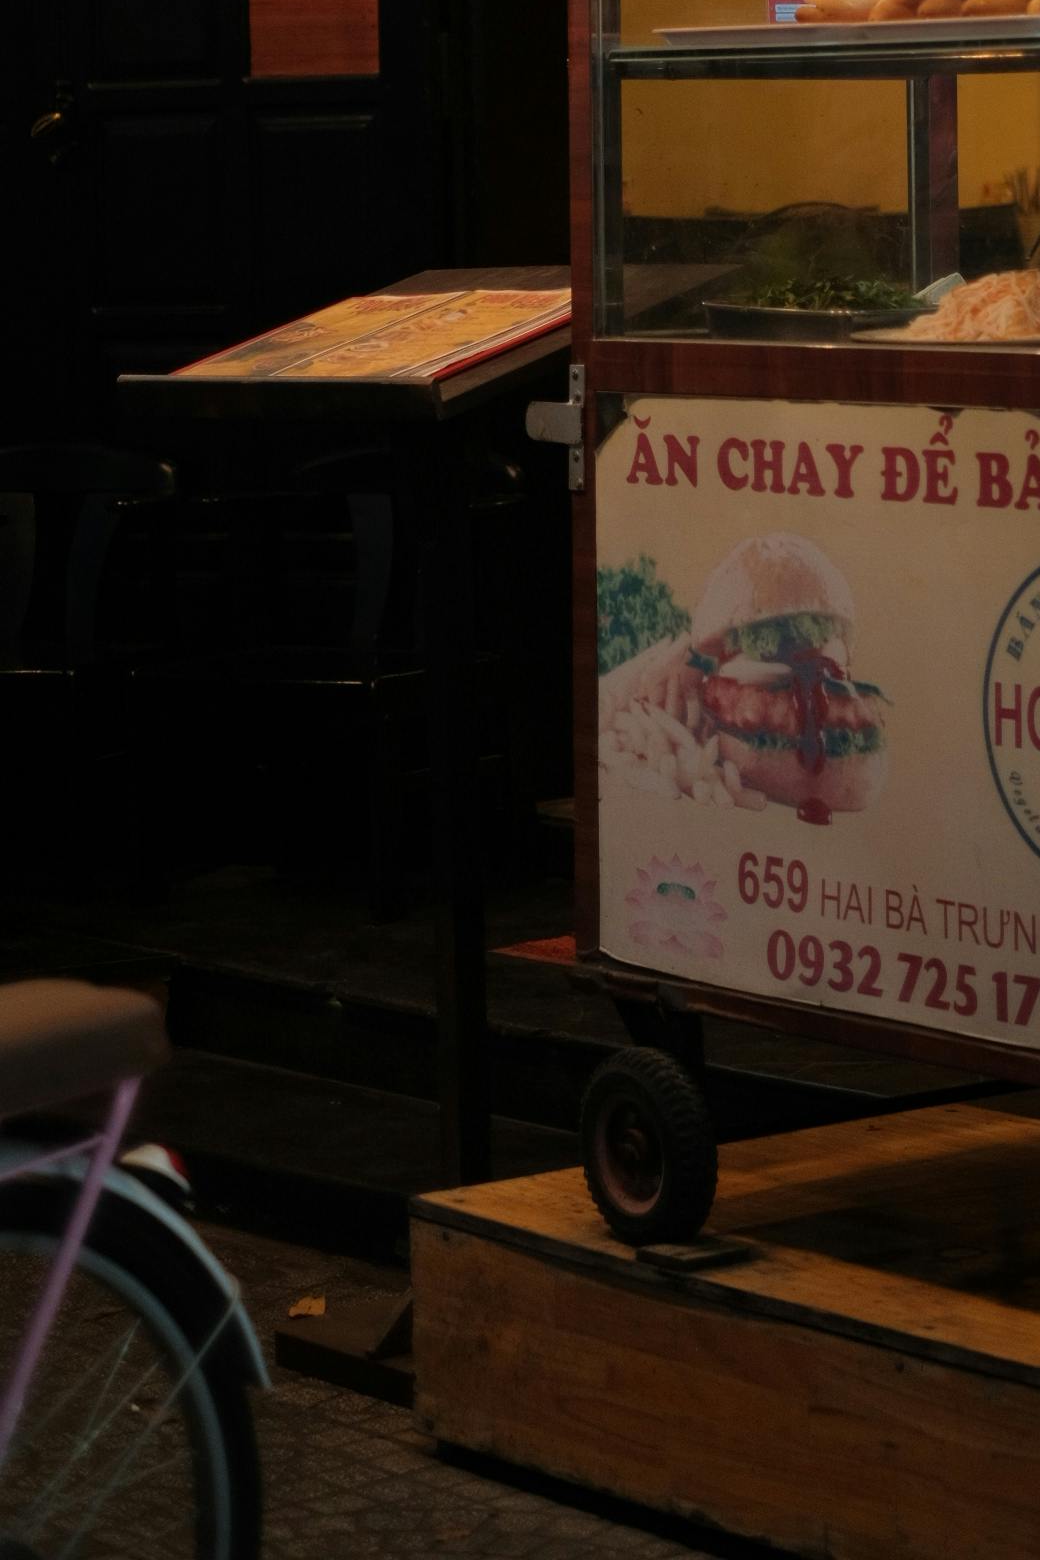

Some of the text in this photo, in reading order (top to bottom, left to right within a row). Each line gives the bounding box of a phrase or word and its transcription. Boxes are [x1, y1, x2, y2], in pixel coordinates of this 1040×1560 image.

[626, 415, 701, 489] ĂN
[716, 437, 865, 500] CHAY
[880, 414, 959, 507] ĐỂ
[737, 851, 810, 914] 659
[819, 877, 874, 926] HAI
[884, 884, 928, 937] BÀ
[766, 928, 885, 998] 0932
[896, 950, 979, 1017] 725
